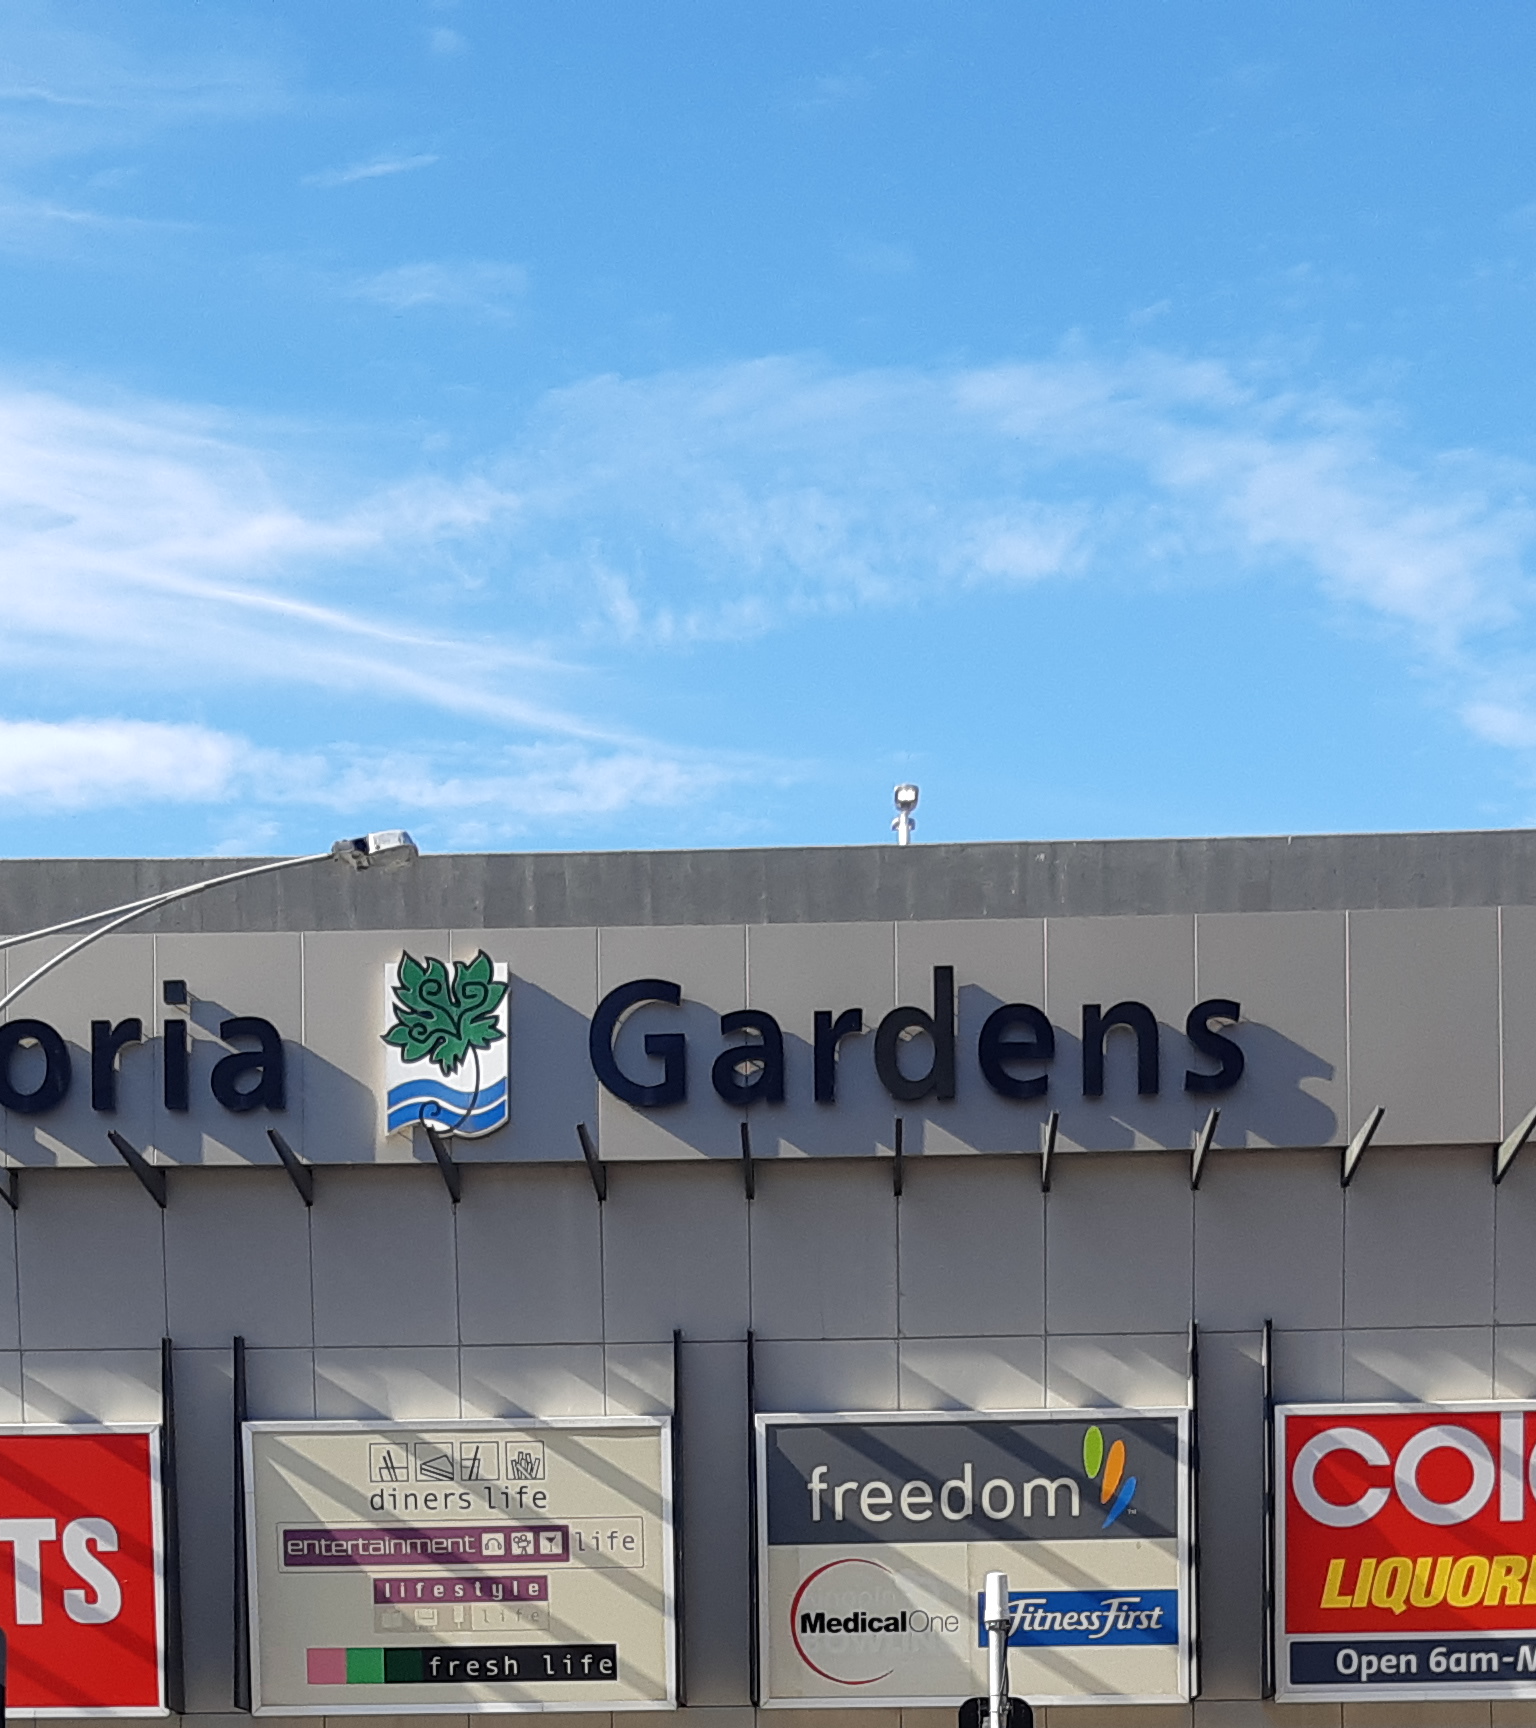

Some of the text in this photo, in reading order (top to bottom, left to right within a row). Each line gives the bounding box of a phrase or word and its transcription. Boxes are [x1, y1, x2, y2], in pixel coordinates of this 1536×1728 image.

[589, 966, 1245, 1108] Gardens
[370, 1487, 548, 1511] diners life
[807, 1463, 1080, 1521] freedom
[287, 1531, 636, 1556] entertainment life
[384, 1581, 540, 1601] lifestyle
[482, 1607, 539, 1624] life
[800, 1610, 959, 1634] MedicalOne
[429, 1654, 613, 1677] fresh life
[1336, 1648, 1417, 1681] Open
